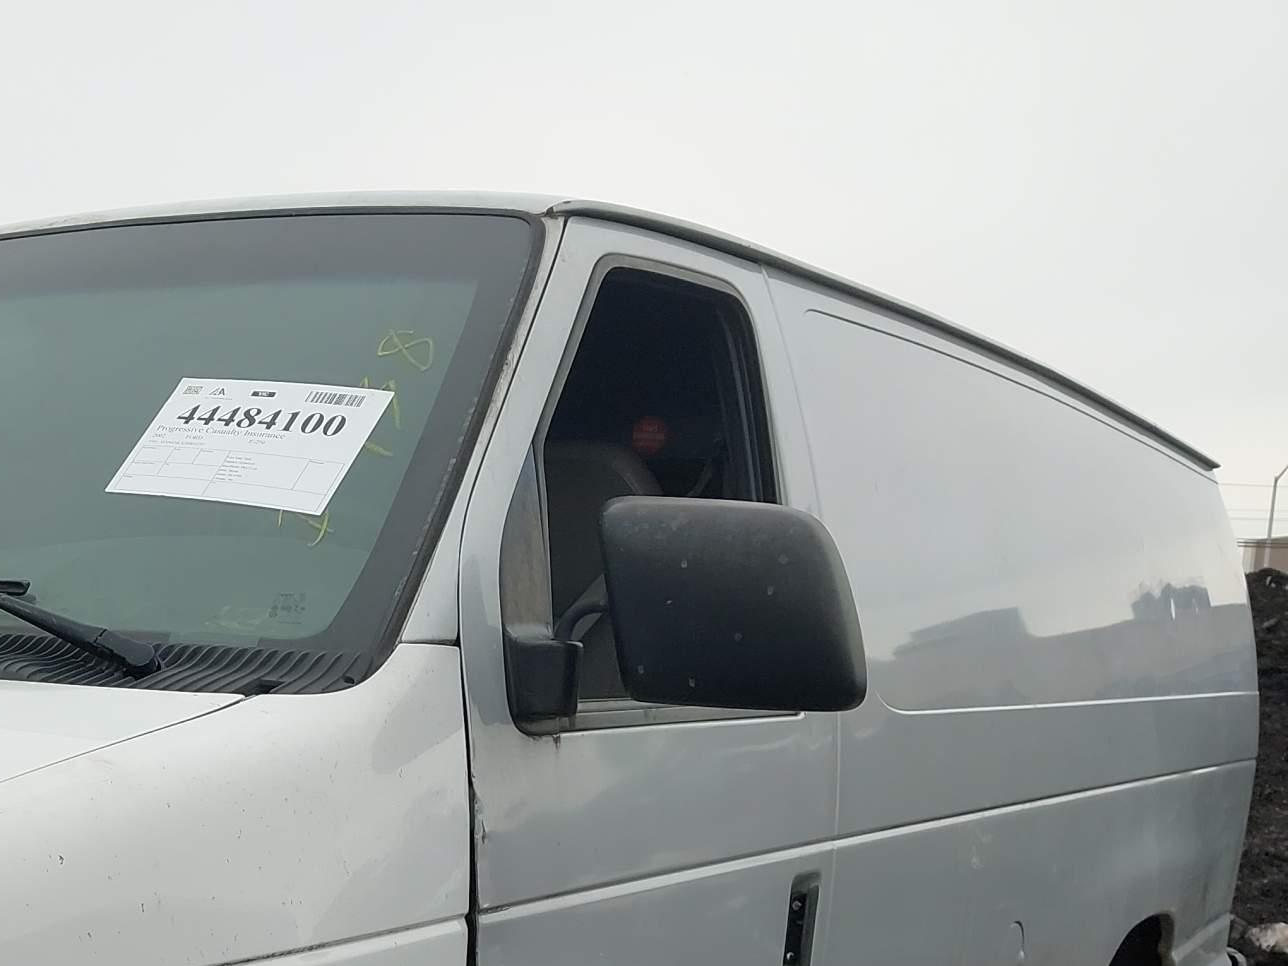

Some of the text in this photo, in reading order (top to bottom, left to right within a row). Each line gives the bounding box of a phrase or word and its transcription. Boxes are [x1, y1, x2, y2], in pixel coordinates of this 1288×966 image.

[156, 424, 286, 440] Progressive Casualty Insurance
[176, 403, 347, 438] 44484100
